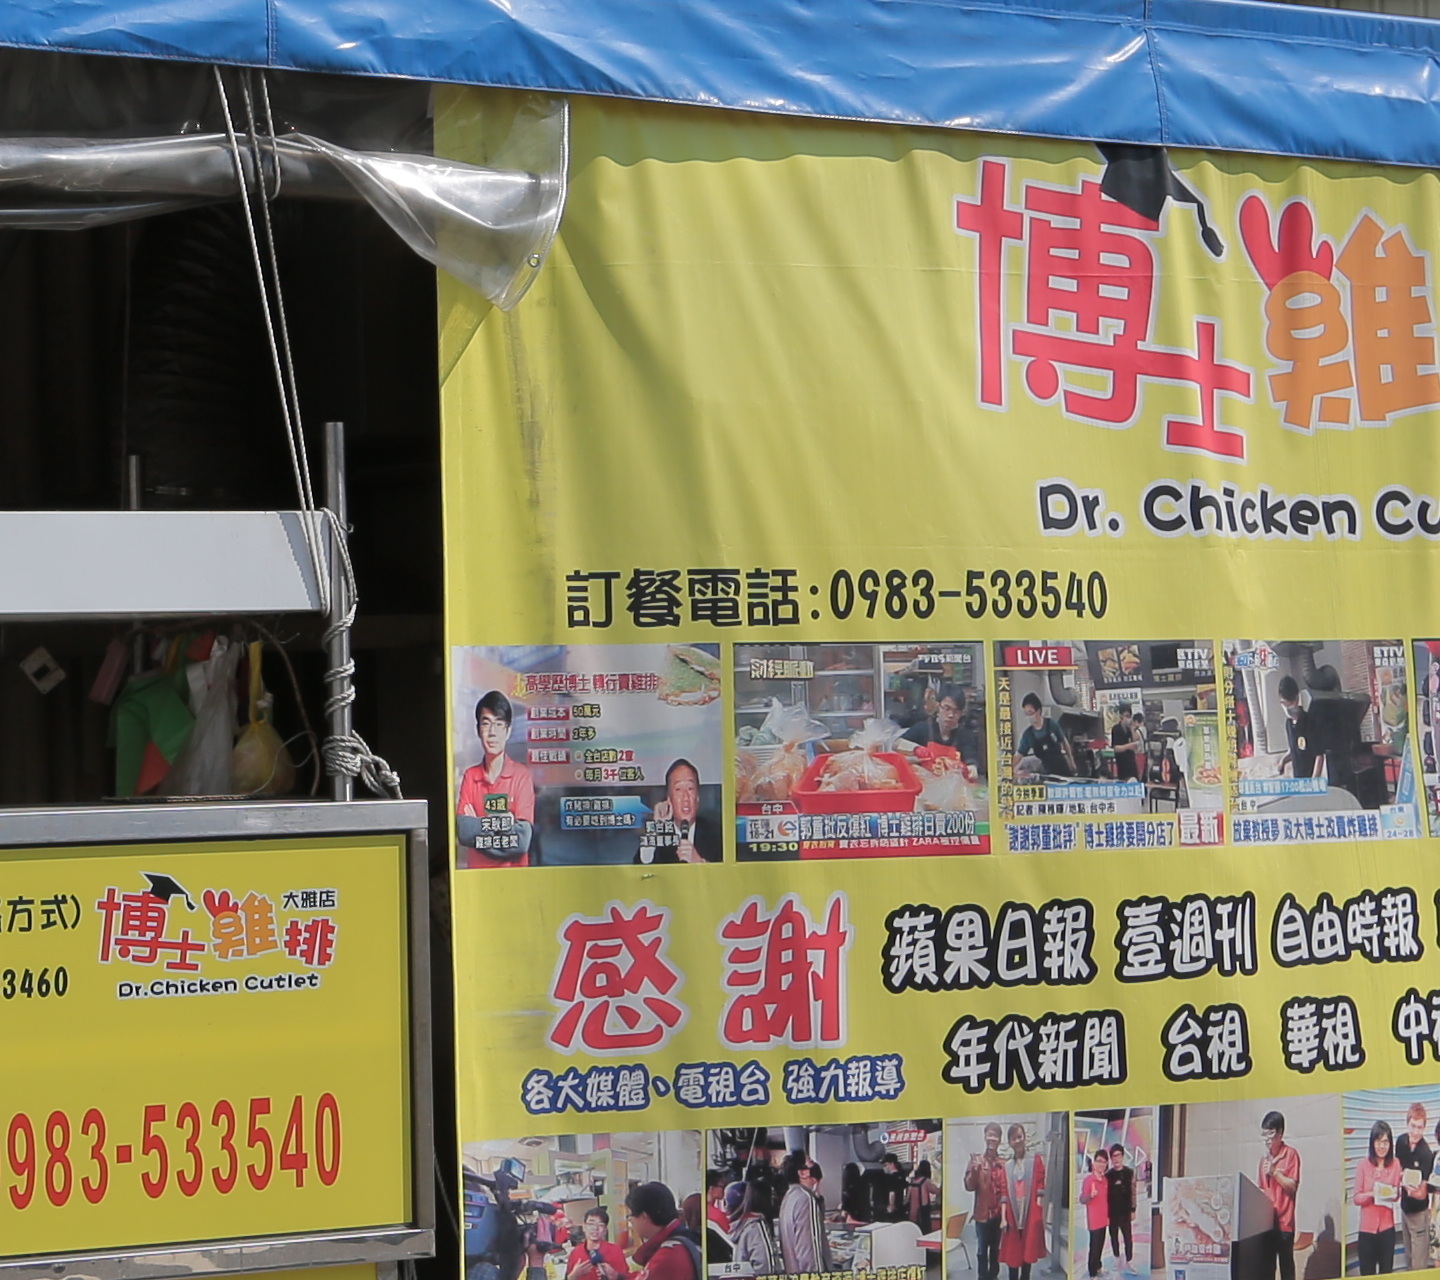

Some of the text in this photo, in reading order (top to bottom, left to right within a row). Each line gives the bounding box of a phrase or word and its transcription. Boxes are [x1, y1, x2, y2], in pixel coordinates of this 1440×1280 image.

[1038, 481, 1120, 533] Dr.
[1141, 483, 1358, 537] Chicken
[564, 566, 1109, 630] 訂餐電話:0983-533540
[525, 674, 590, 693] 高學歷博士
[1017, 649, 1059, 665] LIVE
[761, 804, 783, 815] 台中
[749, 842, 799, 853] 19:30
[96, 887, 337, 974] 博士雞排 大雅店
[889, 908, 1093, 991] 蘋果日報
[1122, 897, 1253, 978] 壹週刊
[1275, 896, 1420, 964] 自由時報
[244, 972, 319, 992] Cutlet
[551, 897, 847, 1050] 感謝
[950, 1018, 1121, 1089] 年代新聞
[1166, 1010, 1248, 1077] 台視
[1285, 1002, 1361, 1069] 華視
[522, 1055, 903, 1113] 各大媒體、電視台 強力報導
